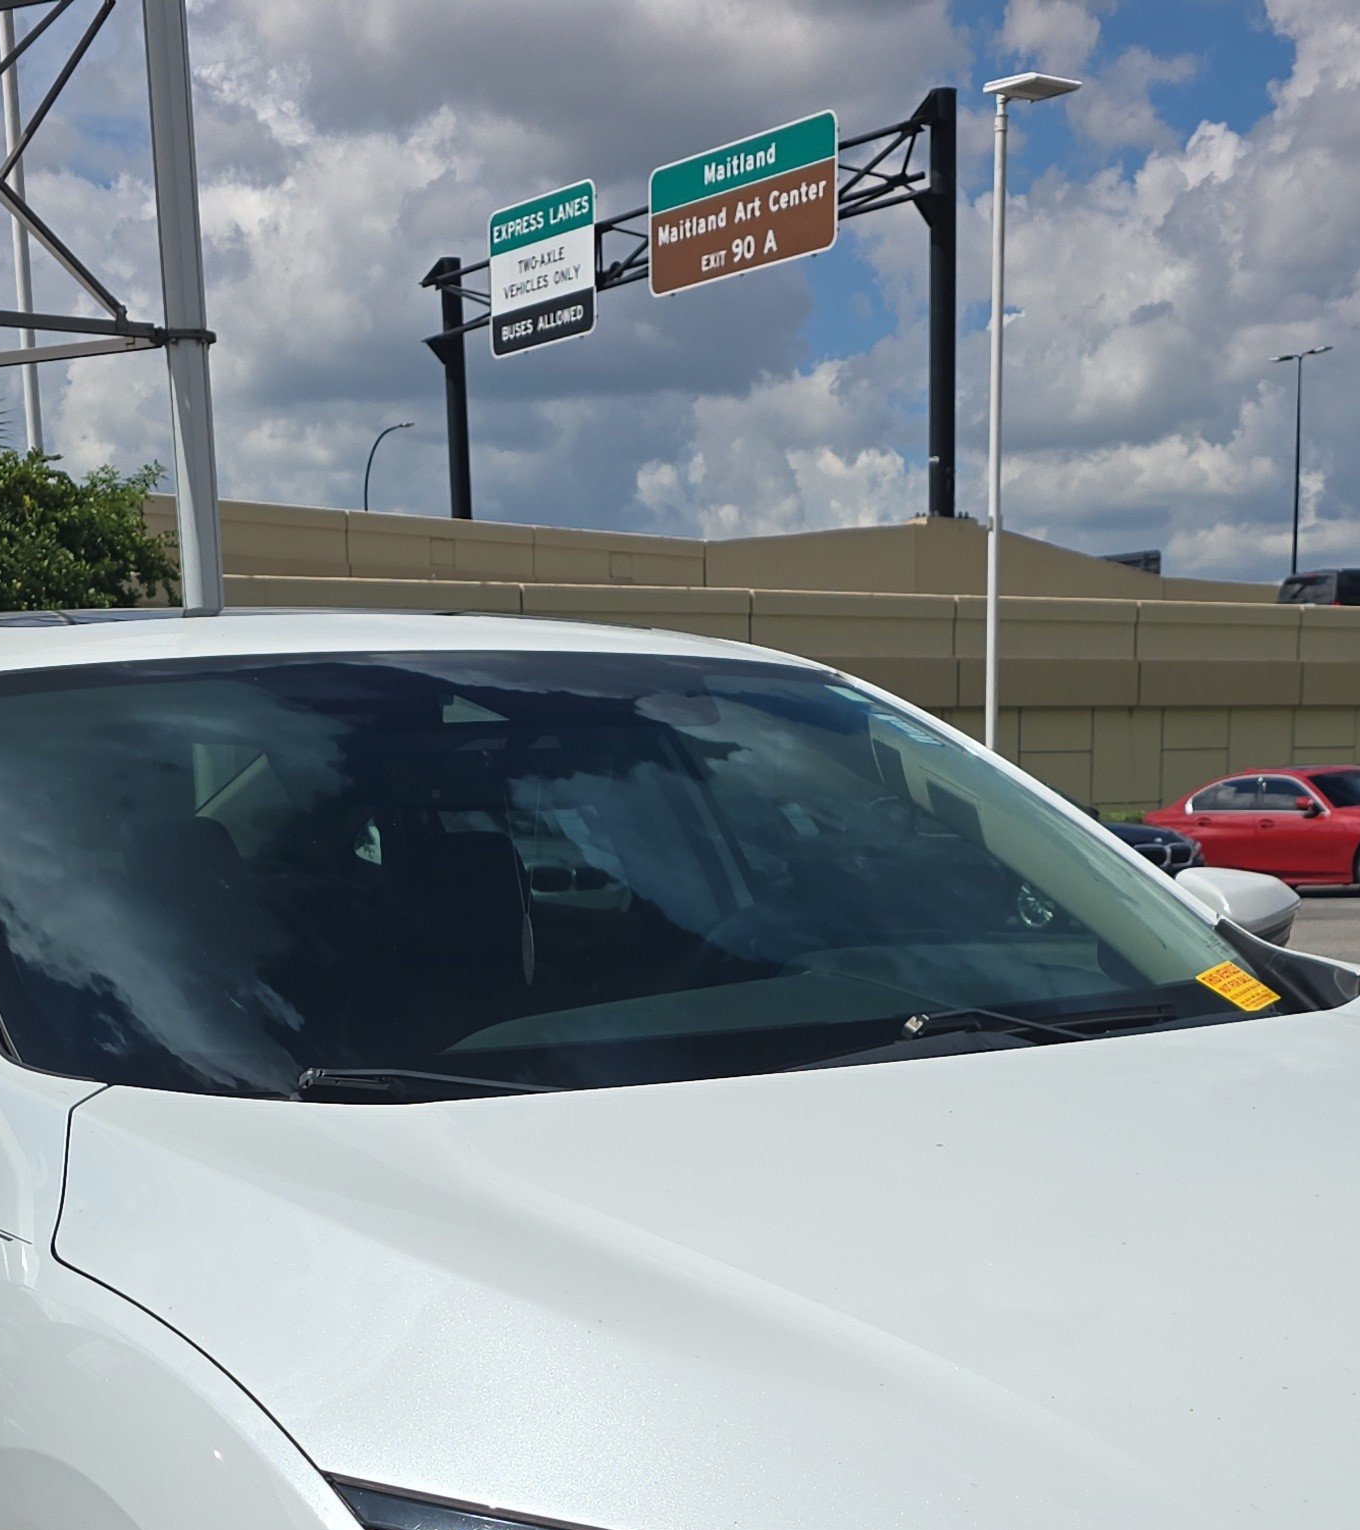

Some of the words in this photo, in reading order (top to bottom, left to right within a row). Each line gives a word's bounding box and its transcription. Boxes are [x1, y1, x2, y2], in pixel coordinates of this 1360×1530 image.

[703, 142, 776, 186] Maitland
[493, 211, 544, 244] EXPRESS
[549, 195, 590, 225] LANES
[657, 206, 727, 247] Maitland
[733, 196, 762, 224] Art
[768, 180, 828, 213] Center
[517, 246, 565, 274] TWO-AXLE
[700, 250, 727, 273] EXIT
[731, 235, 756, 264] 90
[763, 229, 778, 255] A
[503, 274, 549, 300] VEHICLES
[553, 264, 581, 285] ONLY
[501, 318, 534, 342] BUSES
[536, 304, 584, 333] ALLOWED
